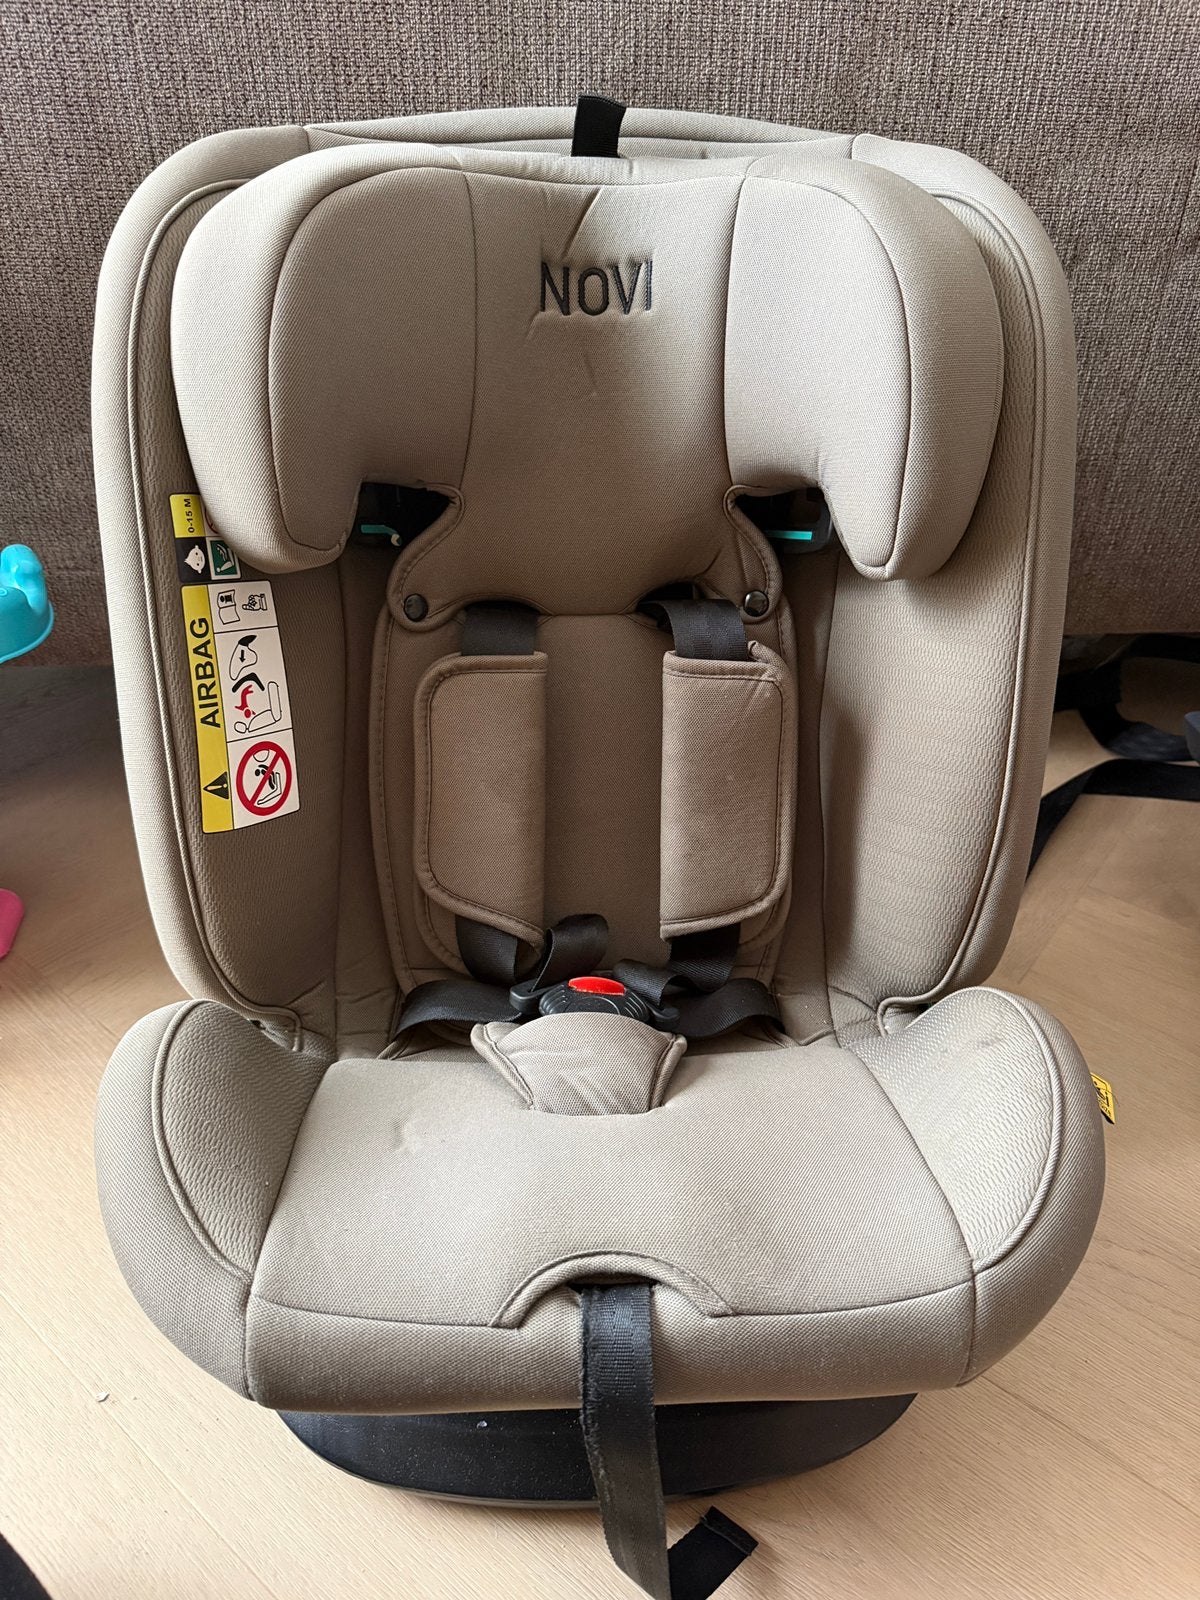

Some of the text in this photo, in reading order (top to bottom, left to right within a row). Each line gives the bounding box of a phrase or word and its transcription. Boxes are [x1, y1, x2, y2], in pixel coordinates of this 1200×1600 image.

[540, 261, 653, 316] NOVI
[183, 498, 195, 533] 0-15 M
[190, 618, 221, 728] AIRBAG
